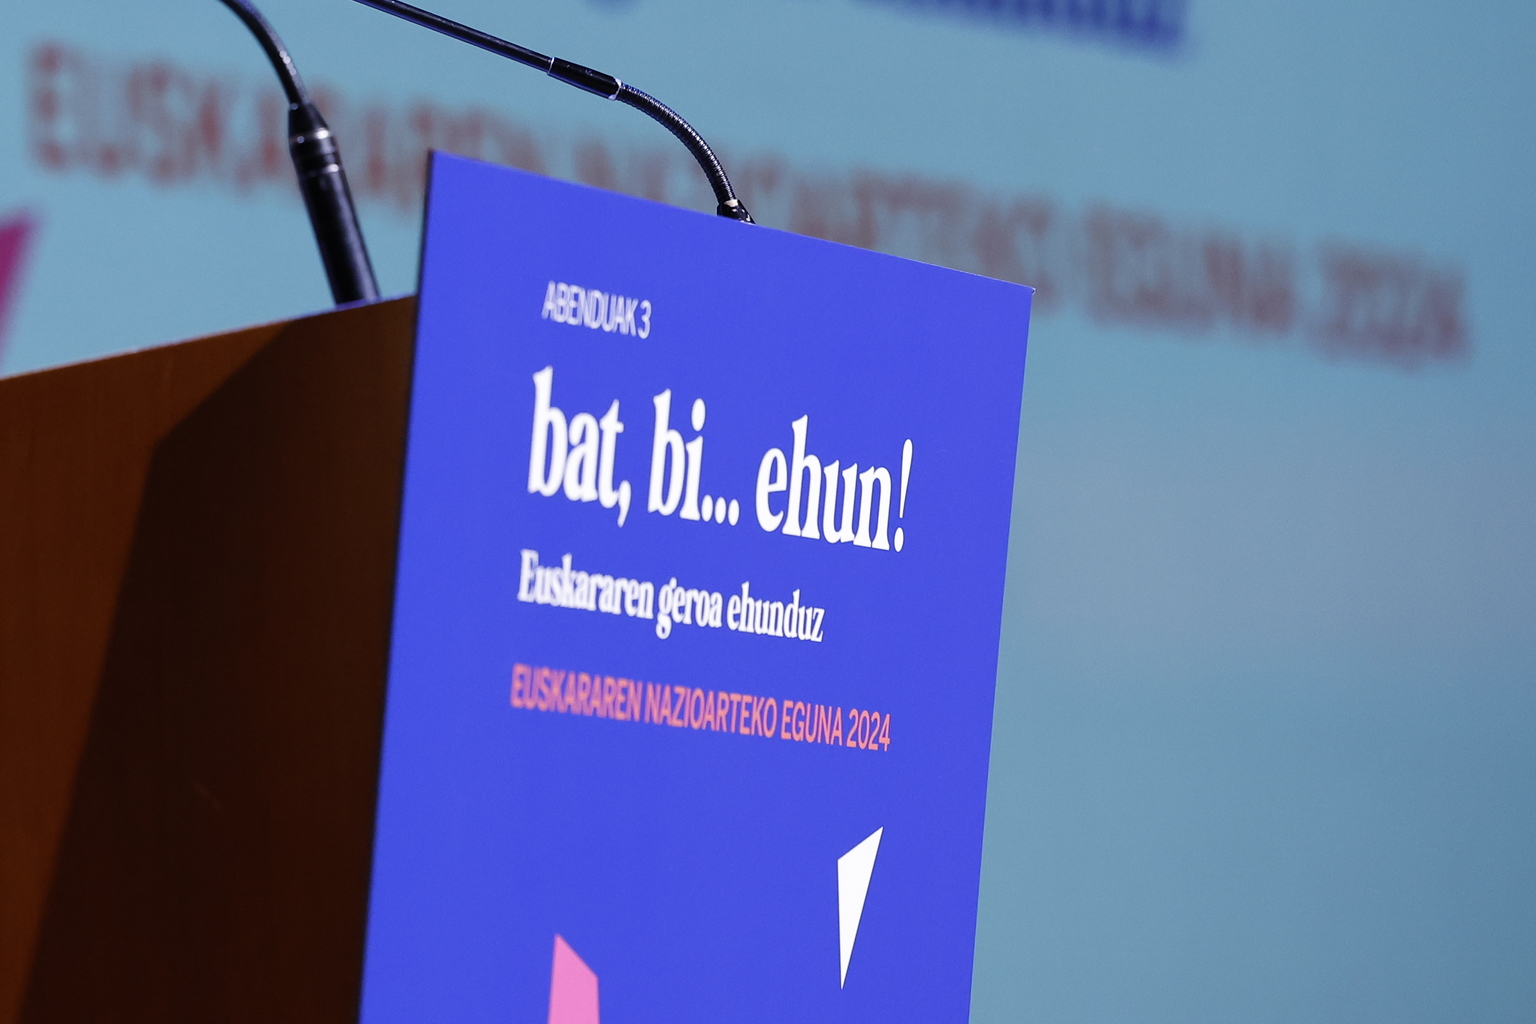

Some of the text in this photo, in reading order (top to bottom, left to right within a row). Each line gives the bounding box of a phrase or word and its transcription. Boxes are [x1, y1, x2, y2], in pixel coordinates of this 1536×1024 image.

[541, 280, 652, 340] ABENDUAK 3
[527, 364, 914, 553] bat, bi... ehun!
[517, 548, 826, 643] Euskararen geroa ehunduz
[510, 662, 892, 752] EUSKARAREN NAZIOARTEKO EGUNA 2024
